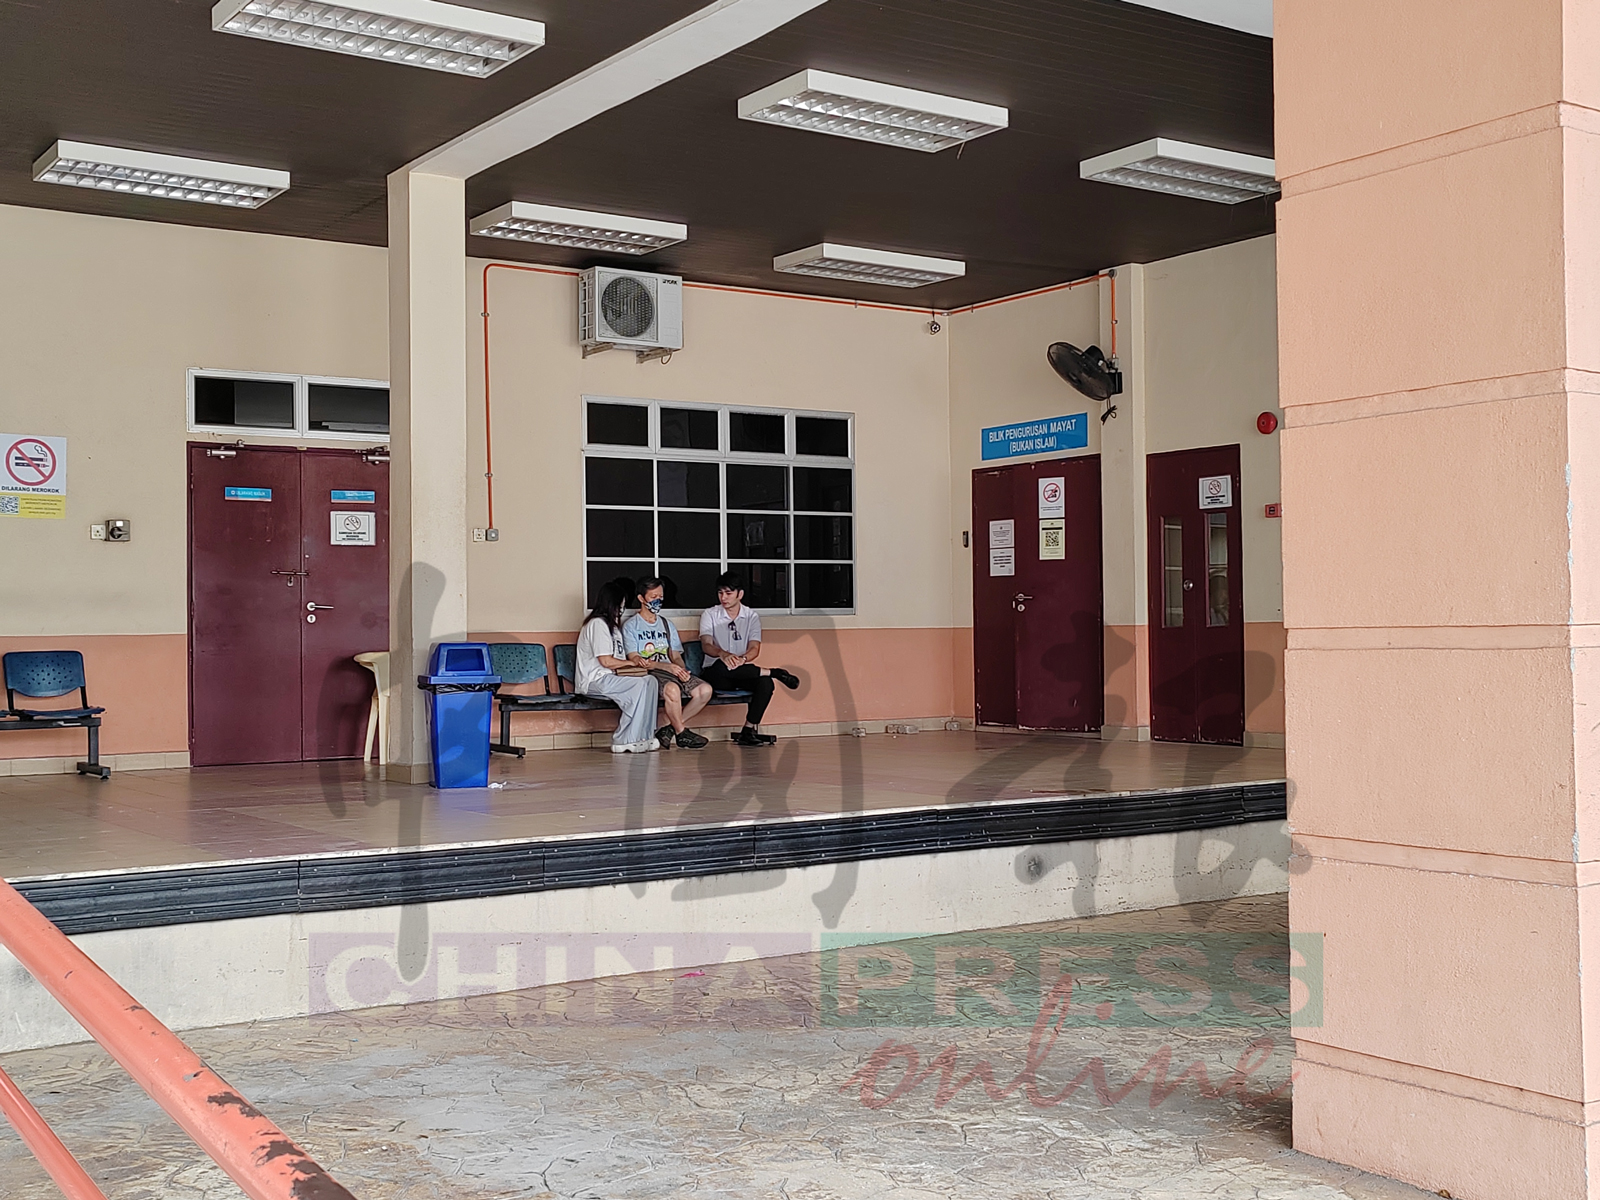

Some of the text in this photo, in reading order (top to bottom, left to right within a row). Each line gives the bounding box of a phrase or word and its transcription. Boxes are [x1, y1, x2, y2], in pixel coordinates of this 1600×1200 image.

[989, 419, 1076, 443] BILIK PENGURUSAN MAYAT
[1010, 436, 1057, 454] (BUKAN ISLAM)
